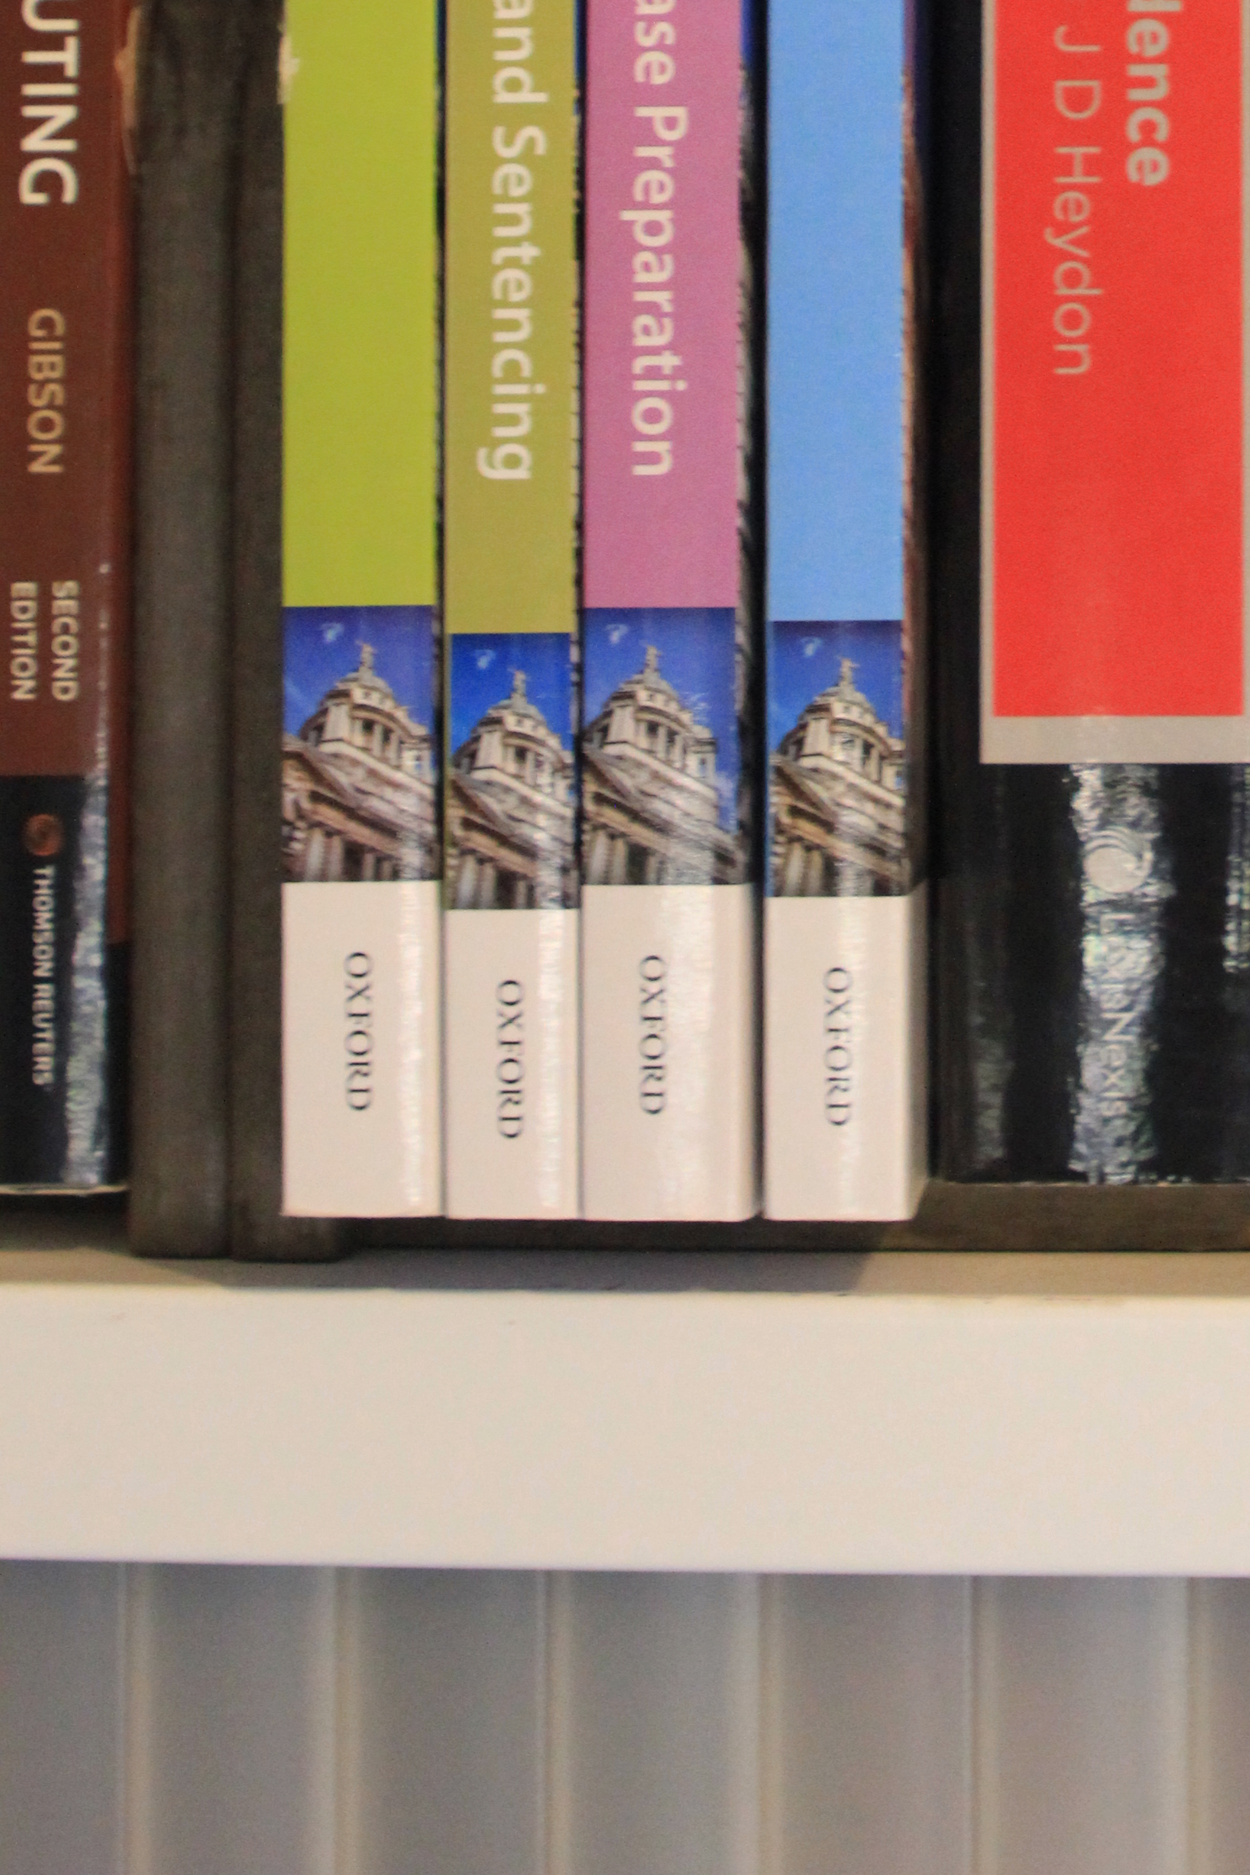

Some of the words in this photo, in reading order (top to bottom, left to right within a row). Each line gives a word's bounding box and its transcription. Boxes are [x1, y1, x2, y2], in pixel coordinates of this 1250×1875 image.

[1053, 26, 1102, 54] J
[1053, 77, 1102, 121] D
[476, 125, 547, 481] Sentencing
[619, 105, 688, 476] Preparation
[1044, 146, 1103, 377] Heydon
[27, 308, 65, 474] GIBSON
[10, 581, 39, 701] EDITION
[51, 580, 80, 702] SECOND
[32, 864, 55, 978] THOMSON
[31, 983, 55, 1086] REUTERS
[343, 950, 374, 1112] OXFORD
[496, 979, 525, 1139] OXFORD
[638, 954, 667, 1116] OXFORD
[823, 966, 853, 1126] OXFORD
